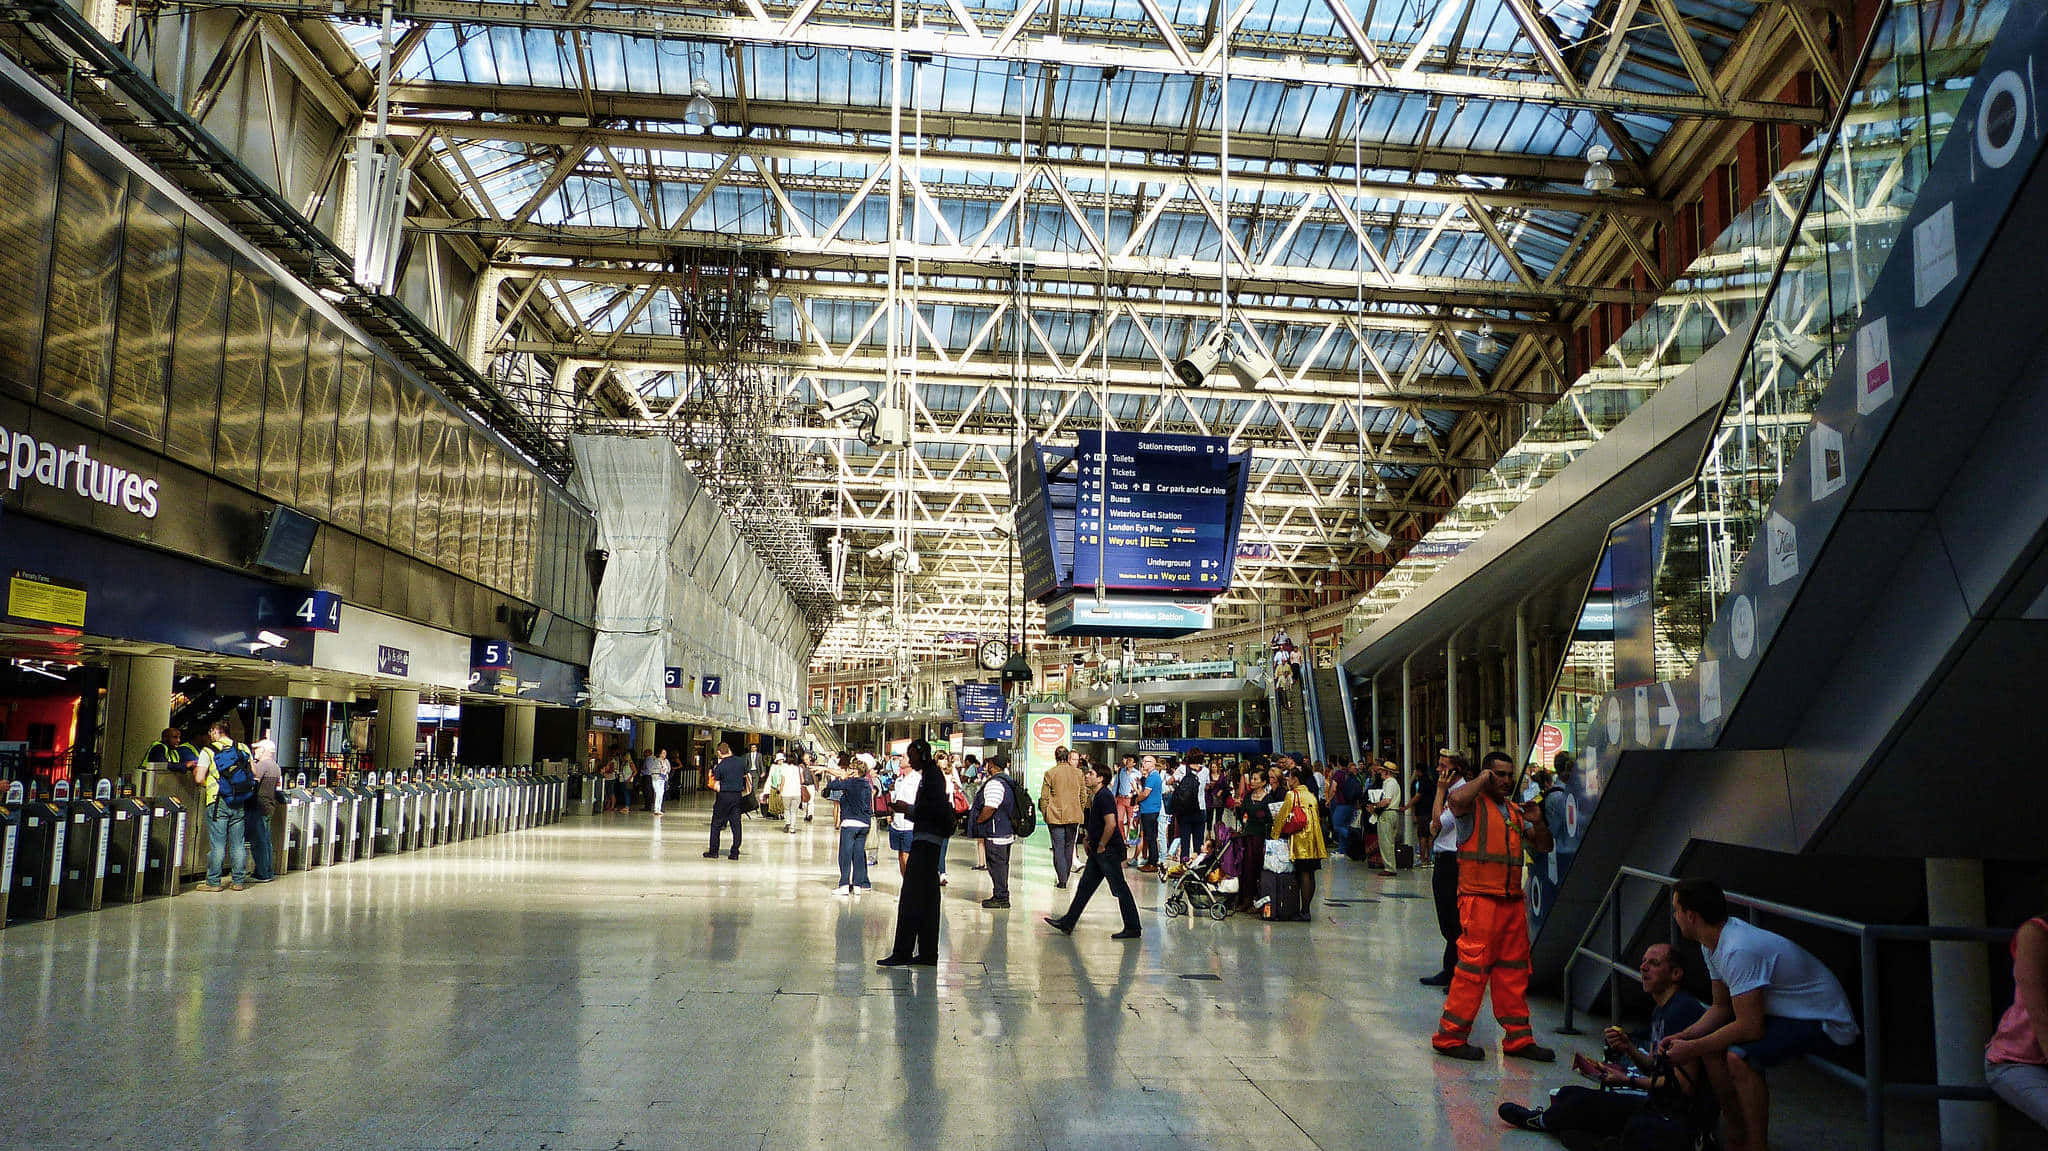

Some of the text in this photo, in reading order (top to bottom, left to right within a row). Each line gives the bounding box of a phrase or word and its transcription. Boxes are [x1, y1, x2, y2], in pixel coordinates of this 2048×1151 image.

[1138, 442, 1196, 453] Station reception
[1112, 454, 1135, 463] Toilets
[1112, 468, 1136, 477] Tickets
[1111, 482, 1128, 490] Taxis
[1157, 484, 1169, 492] Car
[1170, 485, 1185, 494] park
[1200, 486, 1211, 494] Car
[1110, 494, 1131, 503] Buses
[1110, 509, 1182, 520] Waterloo East Station
[1108, 523, 1164, 533] London Eye Pier
[1108, 537, 1124, 546] Way
[1147, 558, 1191, 568] Underground
[1161, 571, 1191, 581] Way out
[296, 597, 315, 622] 4
[329, 601, 337, 625] 4
[485, 645, 499, 663] 5
[665, 671, 675, 684] 6
[707, 680, 715, 692] 7
[750, 696, 757, 705] 8
[770, 703, 777, 711] 9
[1139, 740, 1169, 750] WHSmith
